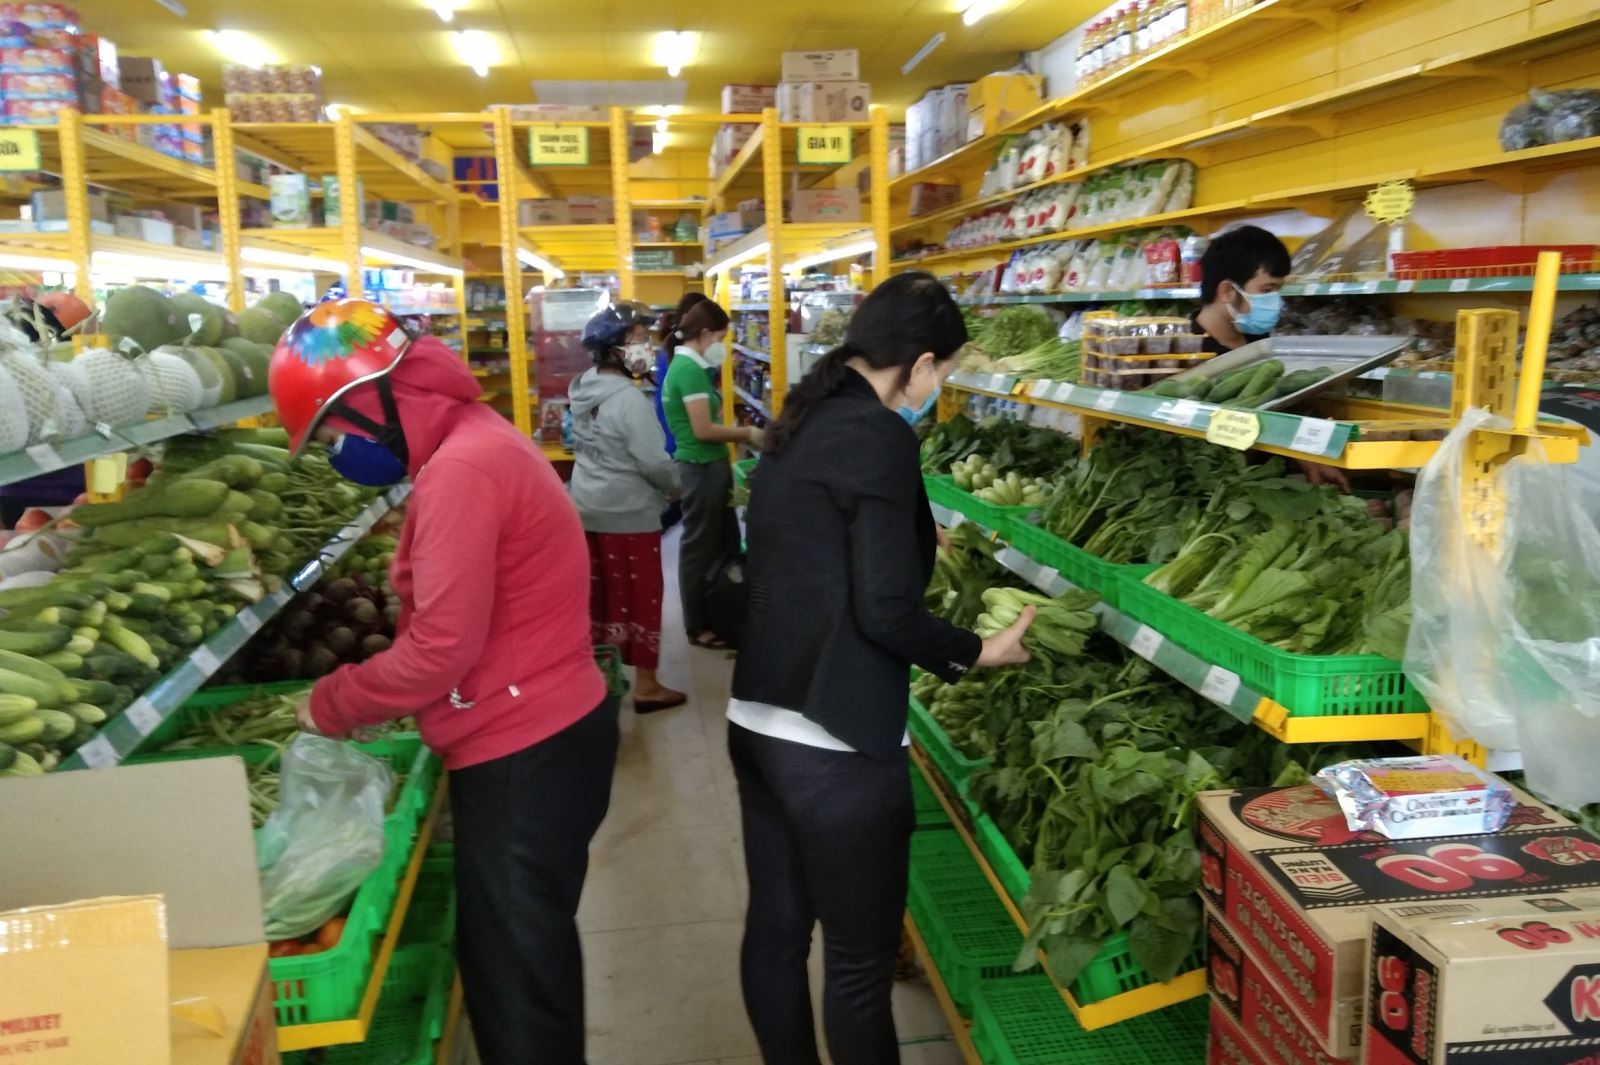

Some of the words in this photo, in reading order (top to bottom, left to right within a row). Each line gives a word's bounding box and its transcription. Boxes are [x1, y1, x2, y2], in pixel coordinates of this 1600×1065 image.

[808, 136, 826, 150] GIA
[1294, 873, 1344, 885] SIÊU
[1375, 843, 1526, 892] 90
[1496, 920, 1573, 950] 90
[1378, 956, 1409, 1031] 90
